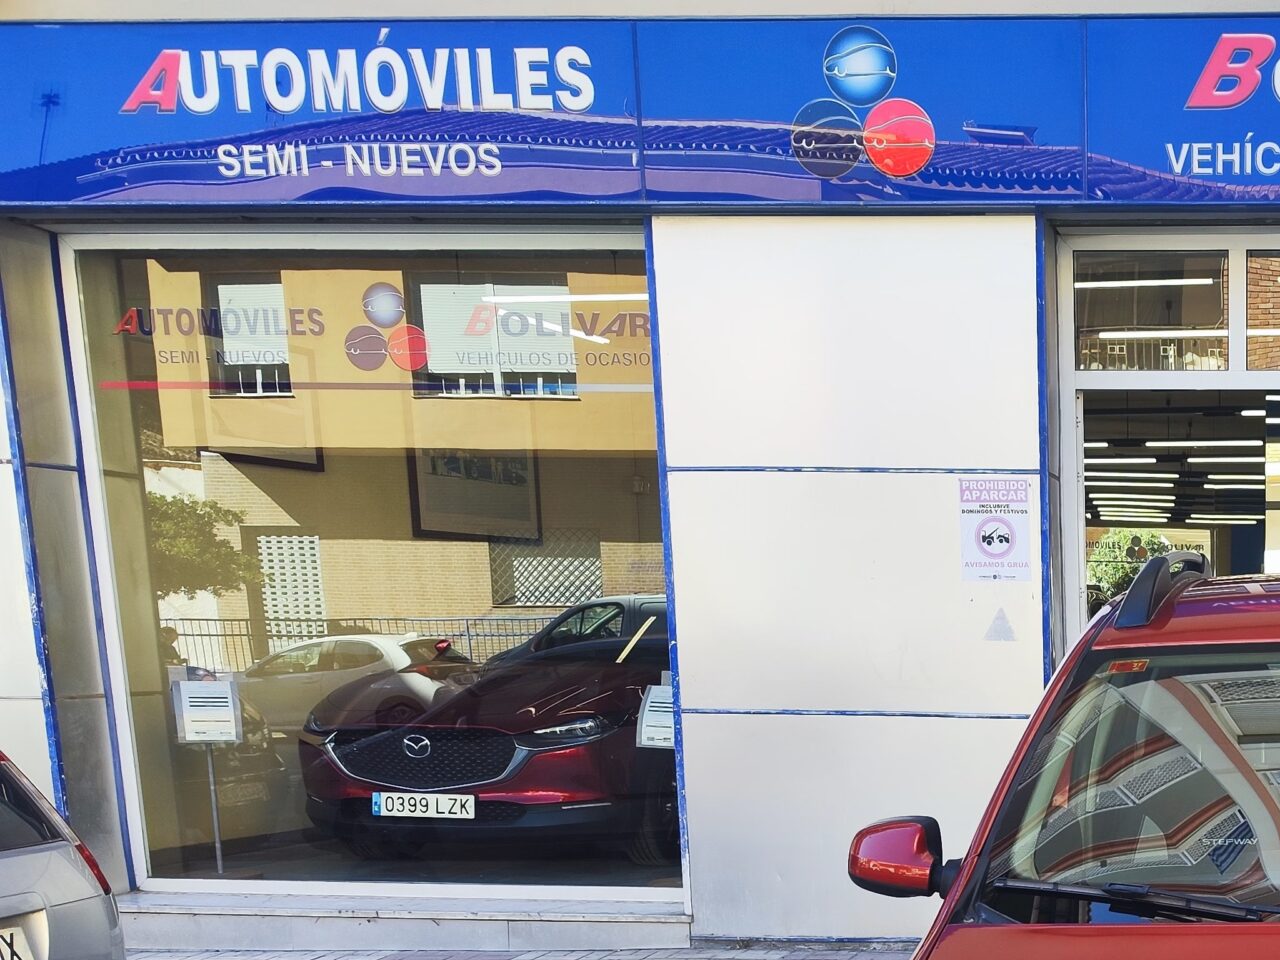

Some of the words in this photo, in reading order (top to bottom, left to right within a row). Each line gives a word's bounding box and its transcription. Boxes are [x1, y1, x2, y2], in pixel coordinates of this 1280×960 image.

[119, 28, 595, 115] AUTOMÓVILES
[217, 141, 309, 177] SEMI
[345, 141, 503, 178] NUEVOS
[112, 299, 325, 337] AUTOMÓVILES
[158, 350, 200, 365] SEMI
[216, 350, 288, 365] NUEVOS
[558, 351, 580, 366] DE
[962, 481, 1026, 490] PROHIBIDO
[962, 490, 1027, 501] APARCAR
[385, 796, 429, 813] 0399
[436, 797, 470, 815] LZK
[1203, 838, 1258, 846] STEPWAY
